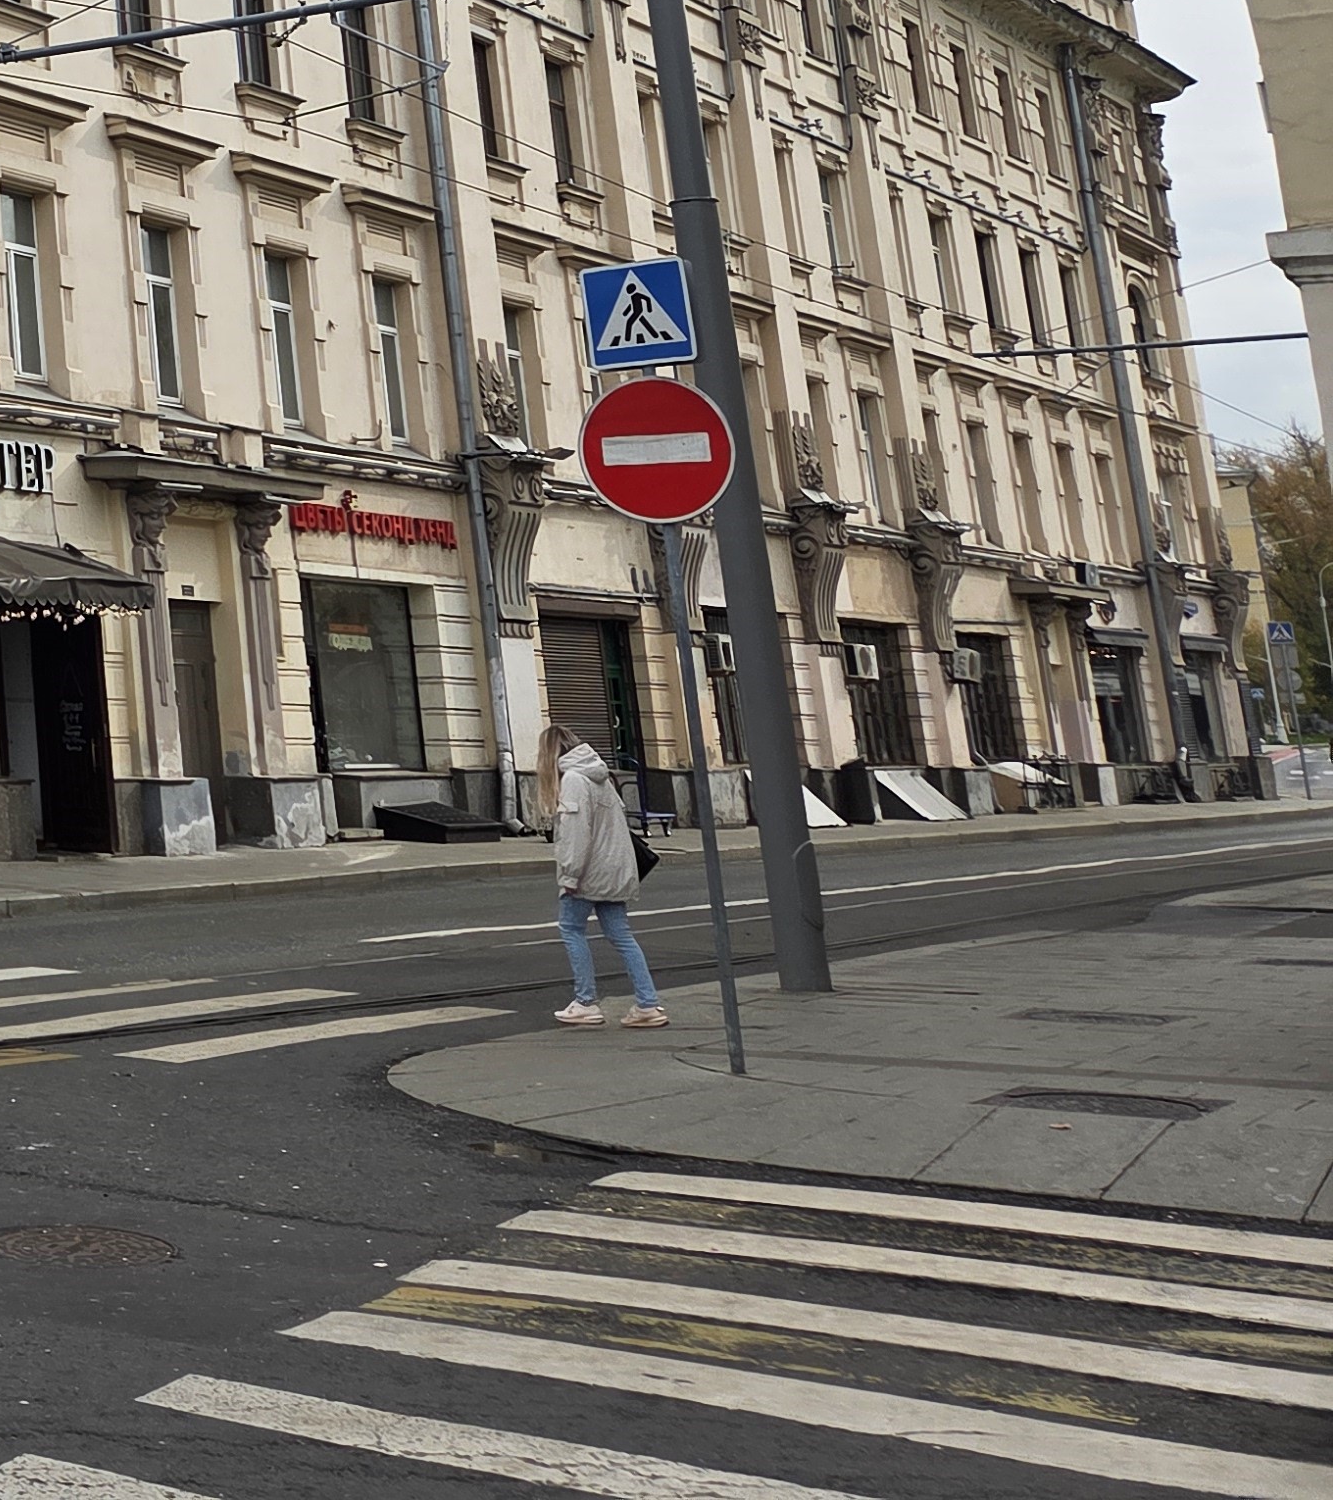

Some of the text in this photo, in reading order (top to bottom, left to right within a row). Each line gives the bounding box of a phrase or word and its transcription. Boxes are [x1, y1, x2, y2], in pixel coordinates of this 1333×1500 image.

[292, 503, 458, 550] ЦВЕТЫ СЕКОНД ХЕНД
